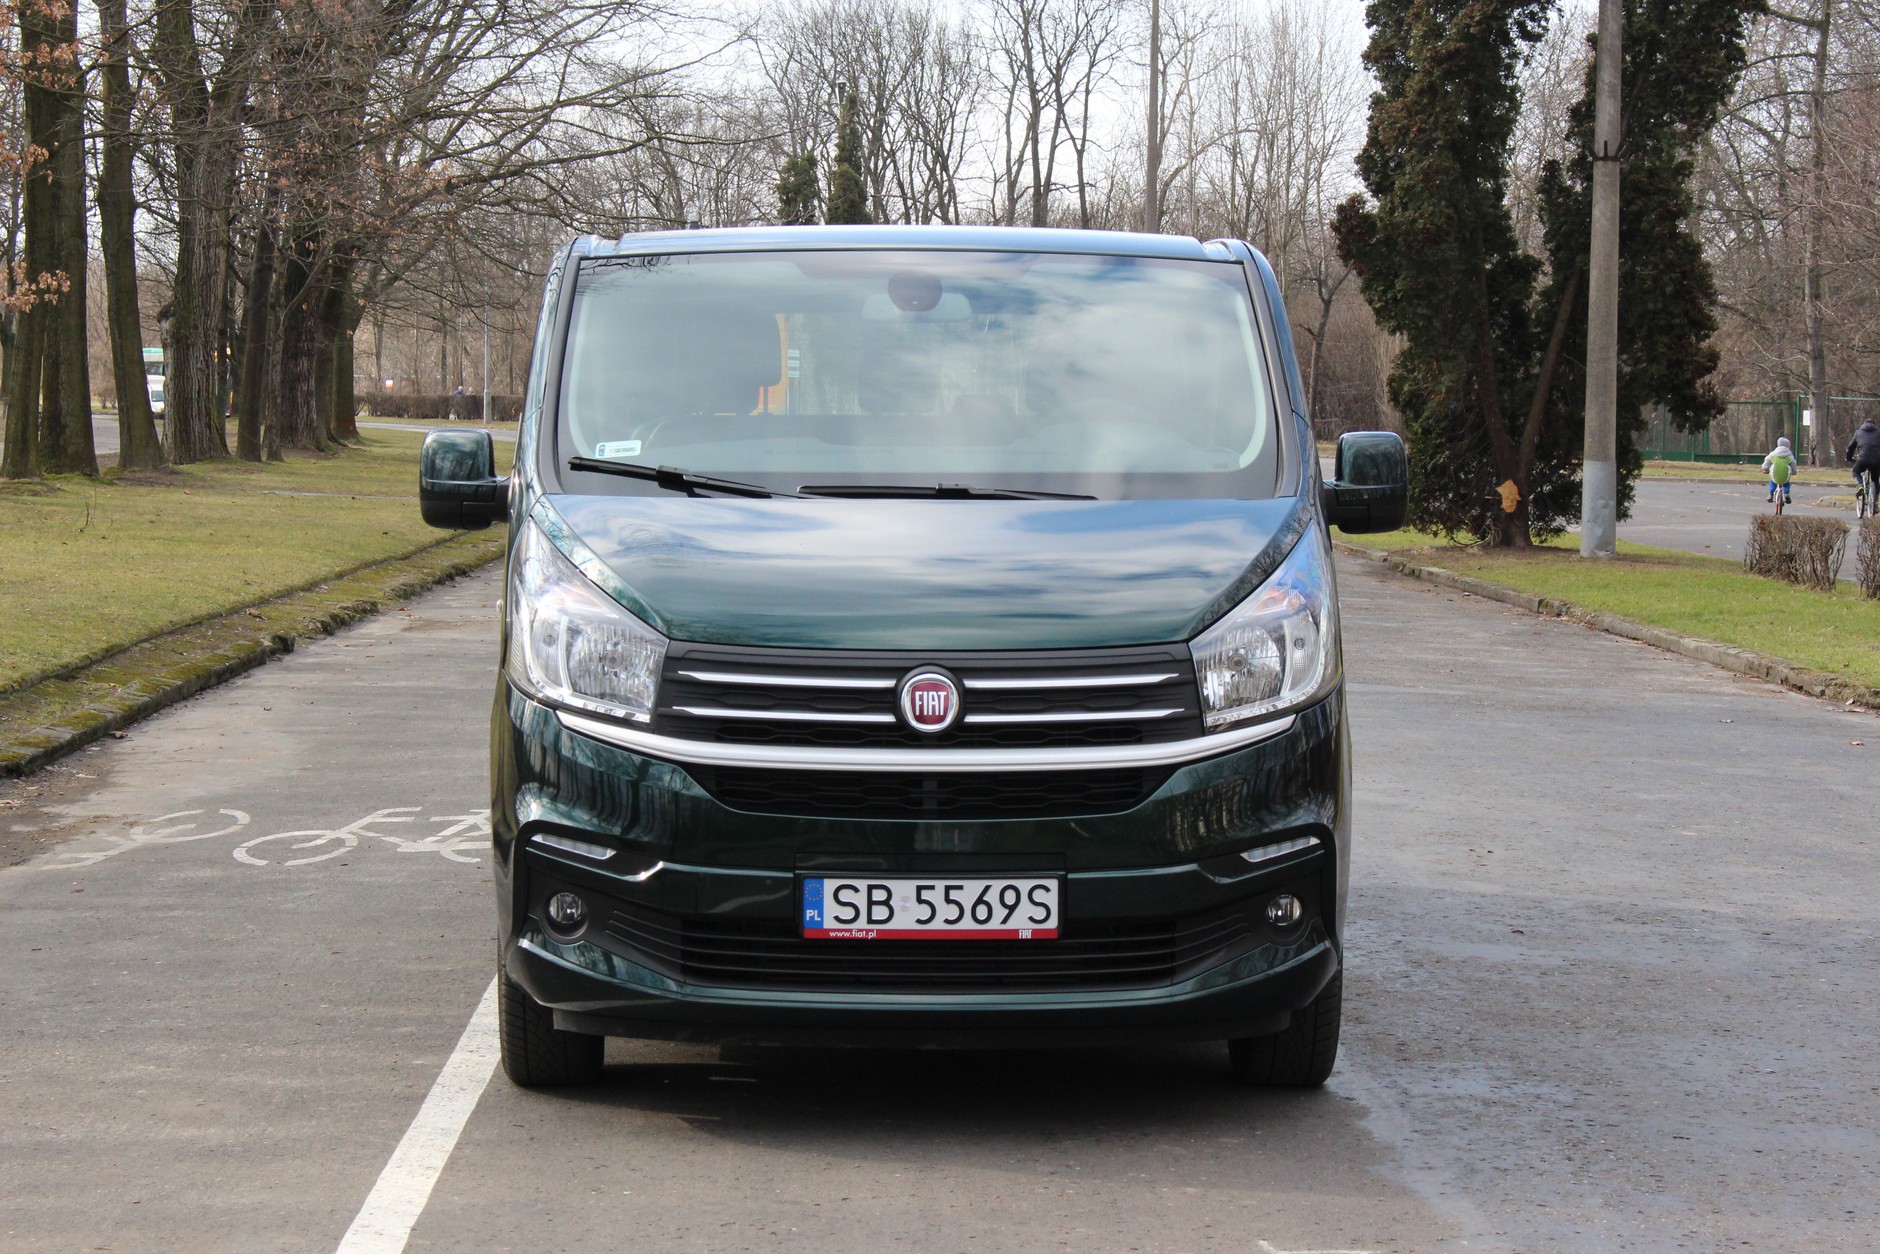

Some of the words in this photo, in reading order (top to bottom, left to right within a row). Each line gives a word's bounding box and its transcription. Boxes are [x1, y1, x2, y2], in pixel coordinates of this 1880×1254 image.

[915, 691, 947, 716] FIAT
[832, 883, 895, 925] SB
[914, 883, 1052, 926] 5569S
[806, 910, 821, 921] PL
[829, 929, 877, 939] www.fiat.pl
[1019, 929, 1032, 939] FIAT
